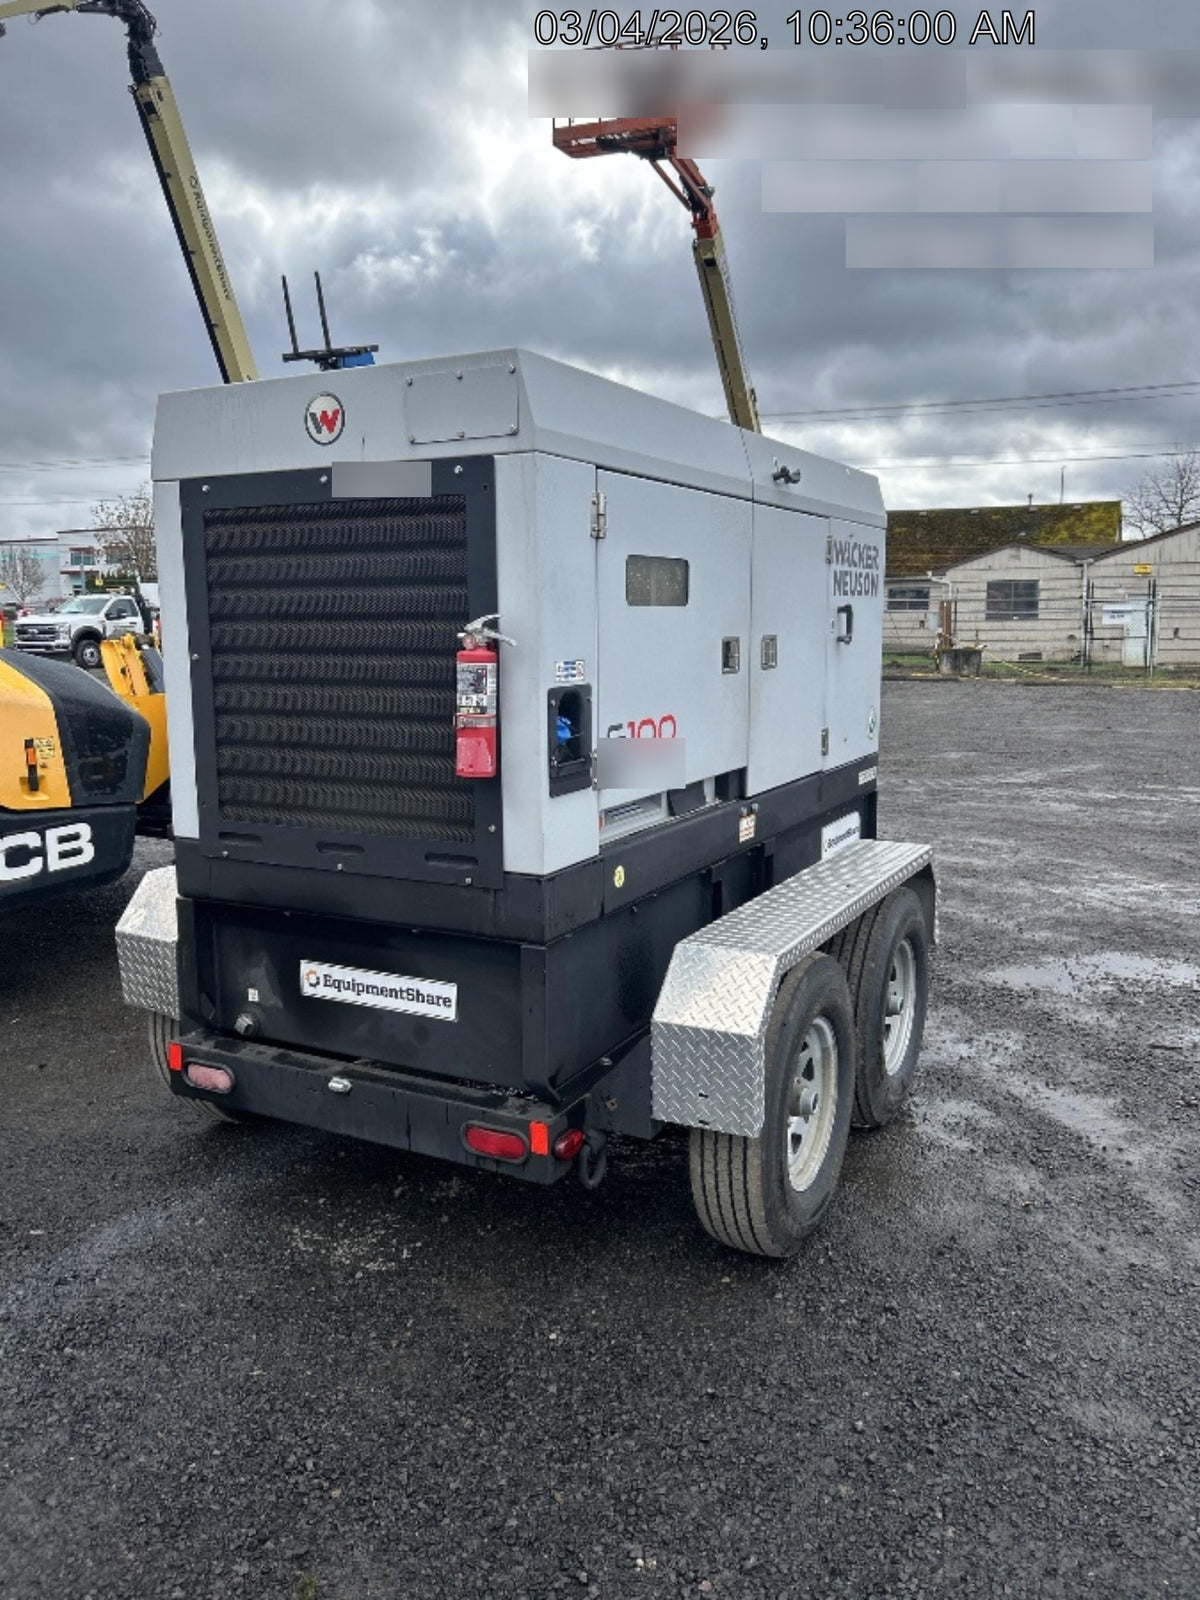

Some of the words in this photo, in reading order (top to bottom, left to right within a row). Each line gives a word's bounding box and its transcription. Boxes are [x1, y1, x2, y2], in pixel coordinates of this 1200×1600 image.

[309, 408, 340, 434] W
[833, 539, 879, 571] WACKER
[833, 570, 879, 597] NEUSON
[323, 974, 452, 1008] EquipmentShare
